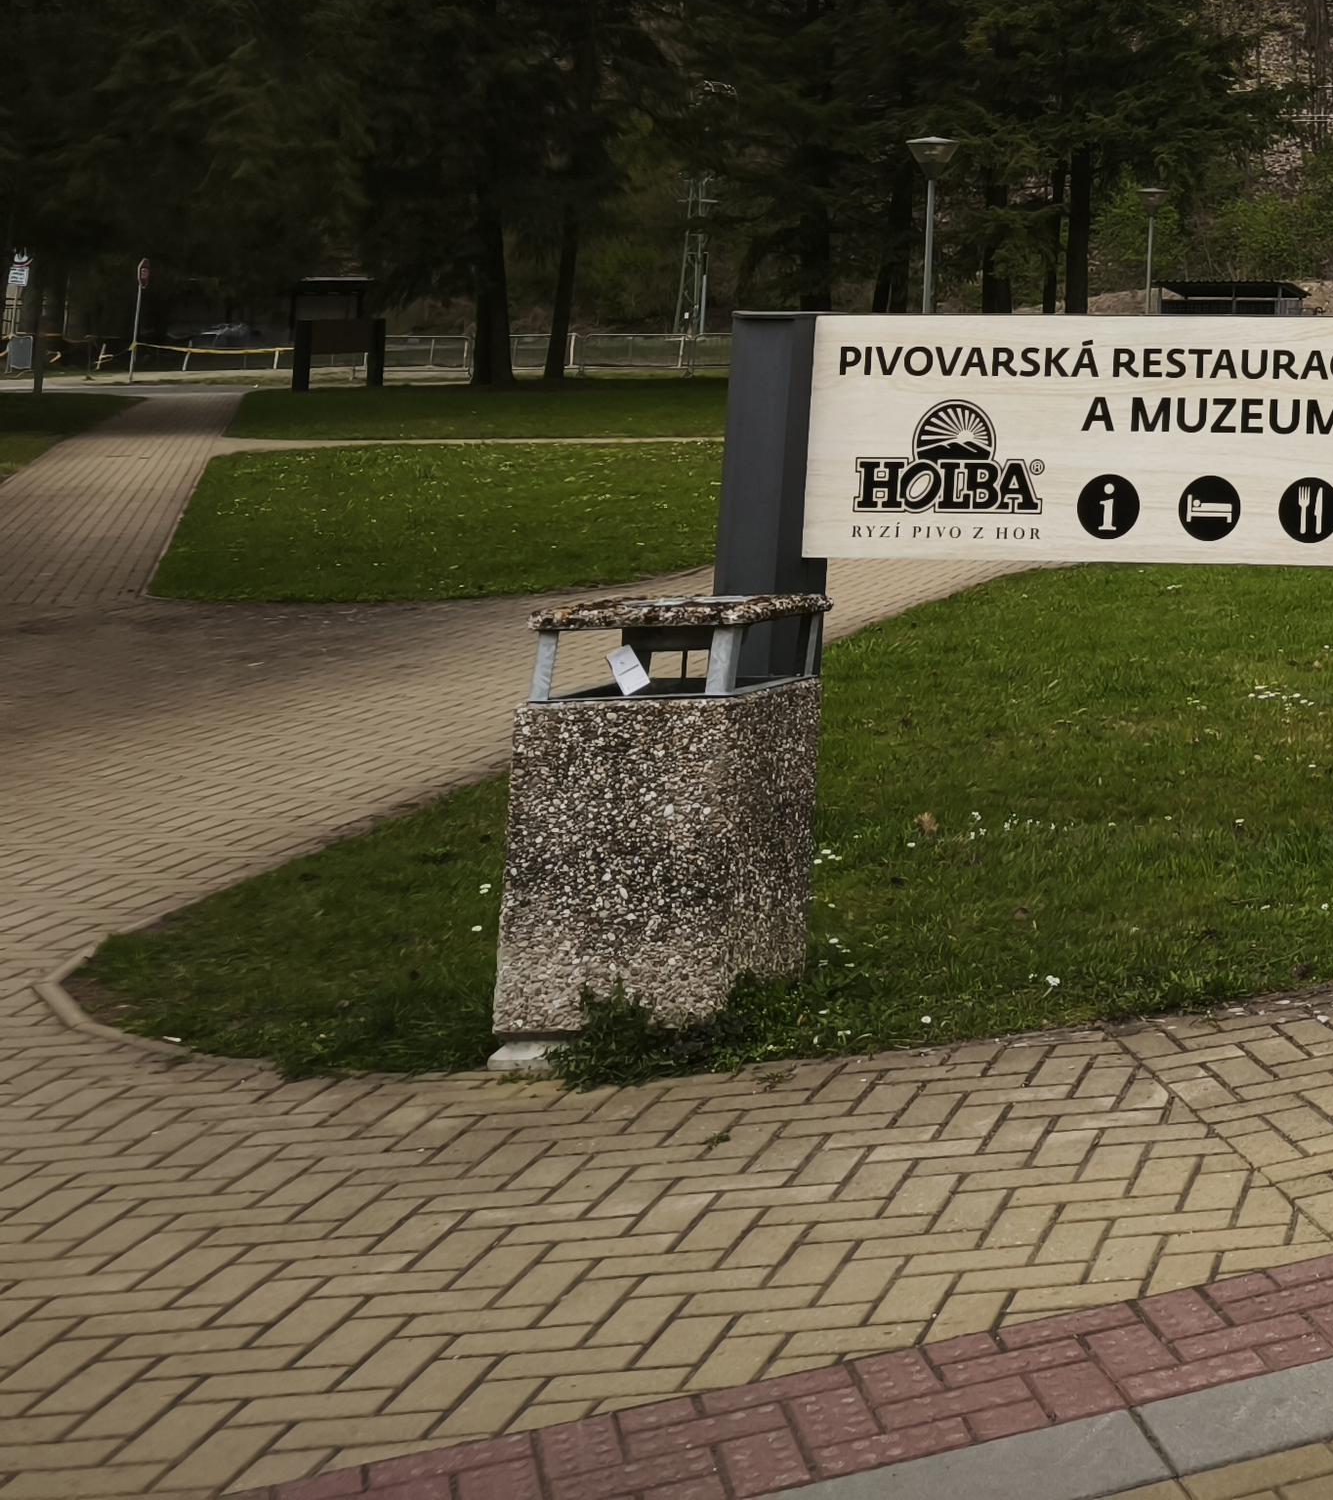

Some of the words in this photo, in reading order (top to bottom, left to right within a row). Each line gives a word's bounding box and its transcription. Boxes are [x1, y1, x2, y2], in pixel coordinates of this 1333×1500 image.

[839, 339, 1099, 378] PIVOVARSKÁ
[1081, 396, 1115, 432] A
[852, 456, 1043, 515] HOLBA
[851, 522, 901, 539] RYZÍ
[912, 525, 962, 540] PIVO
[972, 526, 985, 540] Z
[995, 527, 1041, 541] HOR
